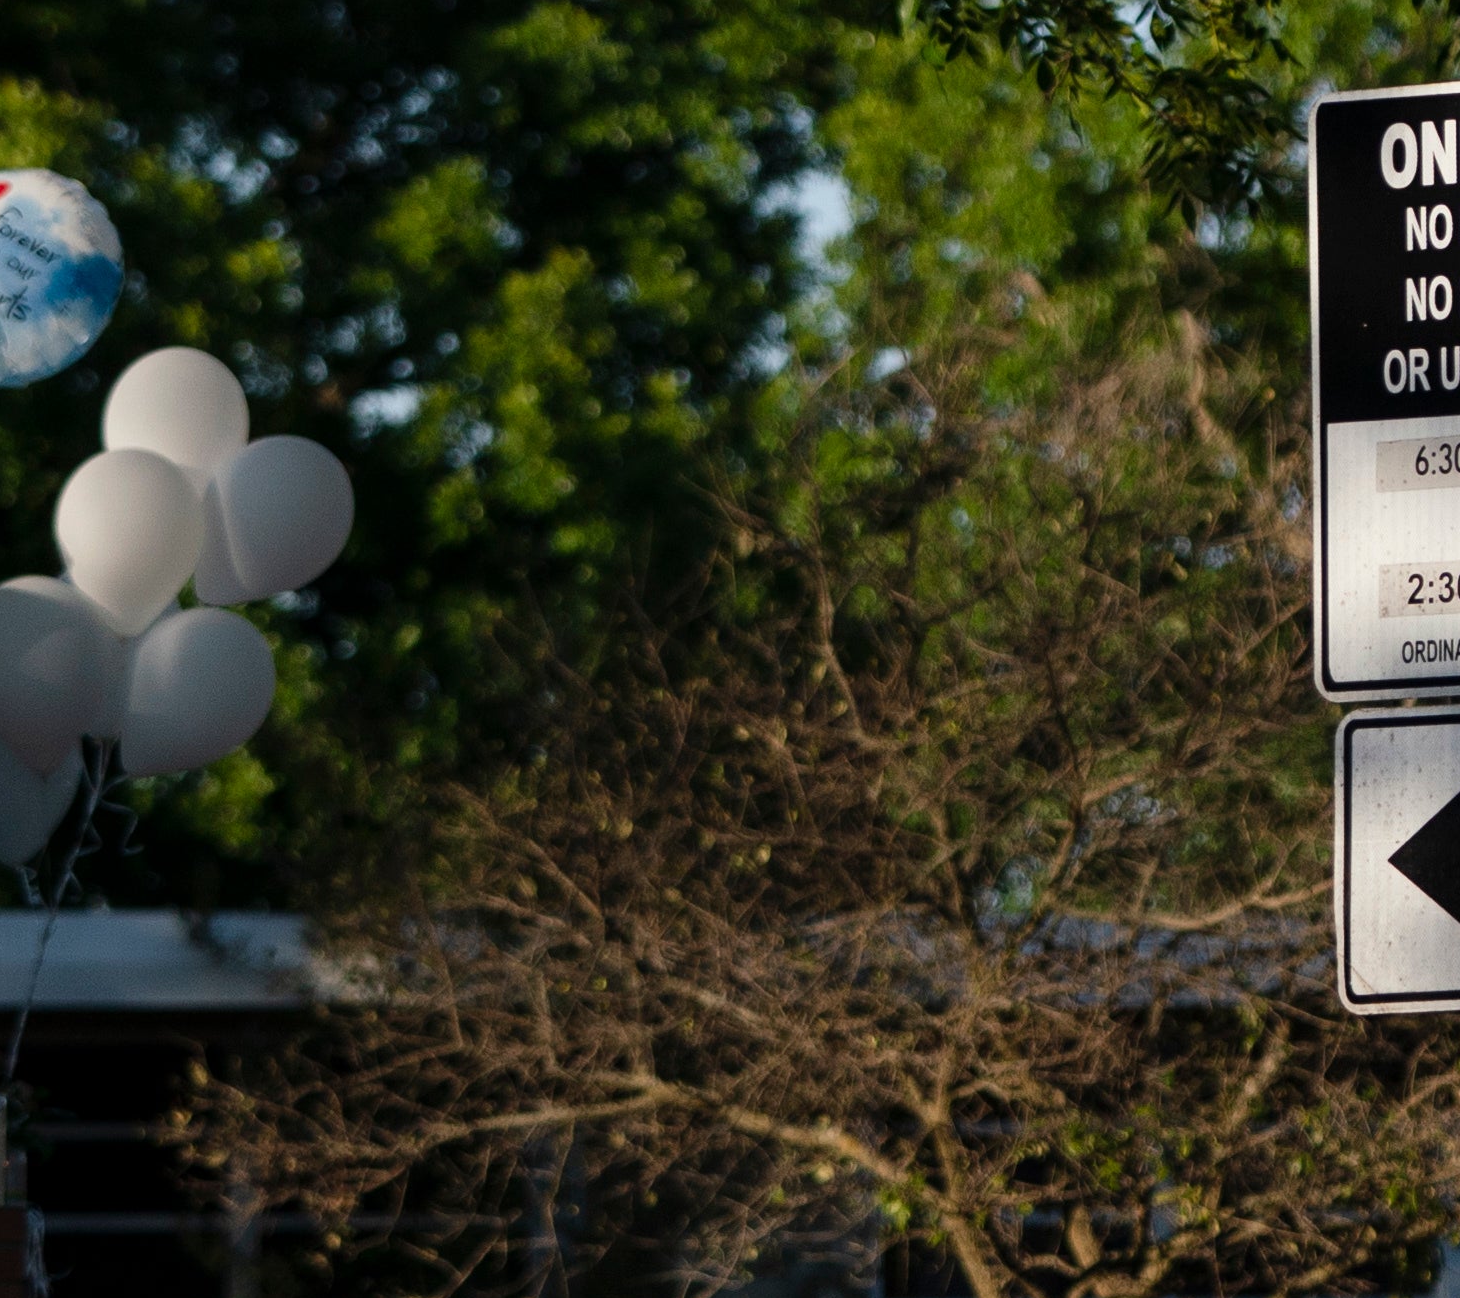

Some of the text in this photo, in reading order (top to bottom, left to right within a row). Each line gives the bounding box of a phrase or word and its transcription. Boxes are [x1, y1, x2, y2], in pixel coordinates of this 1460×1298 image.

[1406, 203, 1454, 252] NO
[1405, 275, 1453, 322] NO
[1383, 347, 1431, 394] OR
